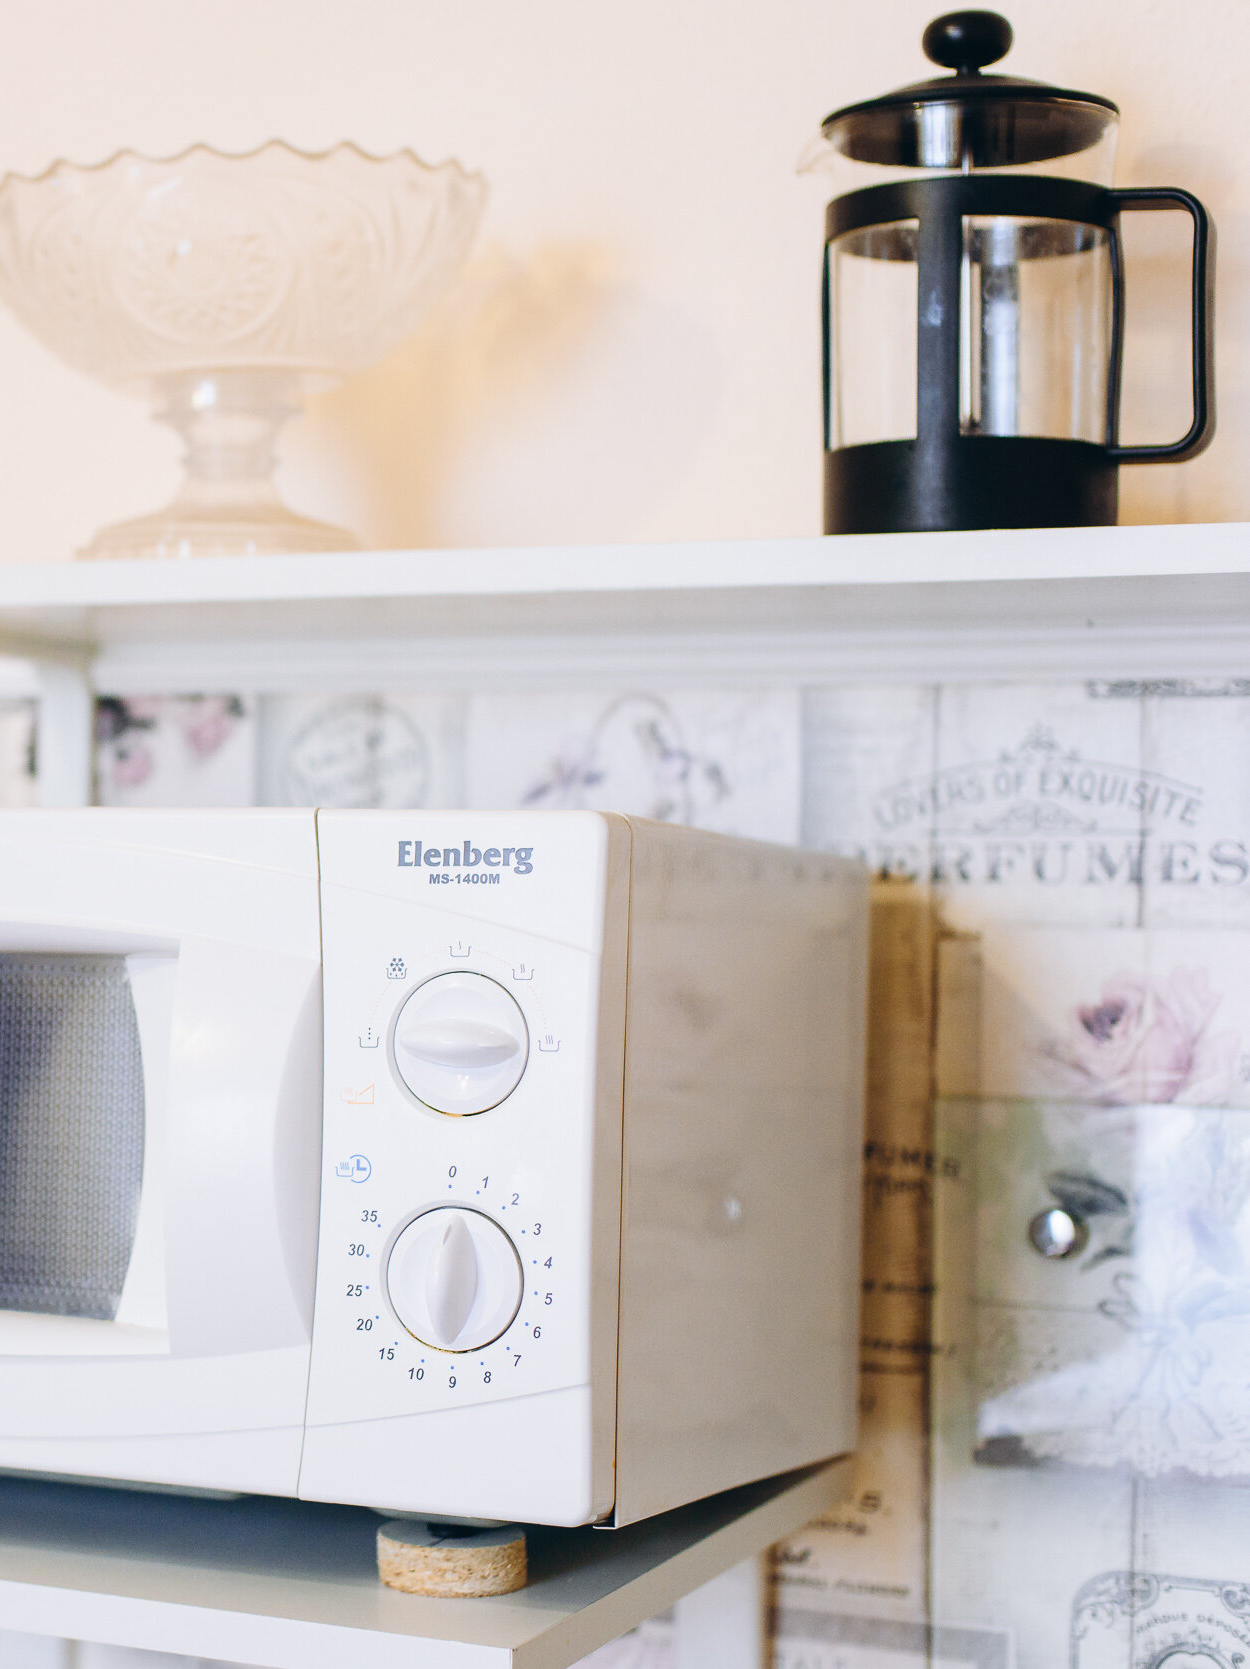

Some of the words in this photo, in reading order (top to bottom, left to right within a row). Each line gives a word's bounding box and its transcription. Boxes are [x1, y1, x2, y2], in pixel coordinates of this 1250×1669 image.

[992, 768, 1026, 798] OF
[1038, 764, 1205, 828] EXQUISITE
[397, 840, 534, 875] Elenberg
[835, 837, 1250, 888] ERFUMES
[428, 873, 501, 885] MS-1400M
[448, 1165, 458, 1179] 0
[481, 1175, 489, 1189] 1
[510, 1192, 520, 1206] 2
[360, 1209, 378, 1223] 35
[532, 1222, 542, 1236] 3
[347, 1243, 365, 1257] 30
[543, 1256, 553, 1270] 4
[345, 1283, 363, 1298] 25
[544, 1292, 553, 1306] 5
[355, 1318, 373, 1332] 20
[532, 1325, 542, 1339] 6
[378, 1347, 395, 1361] 15
[513, 1354, 523, 1368] 7
[407, 1367, 425, 1381] 10
[483, 1370, 492, 1384] 8
[448, 1375, 457, 1389] 9
